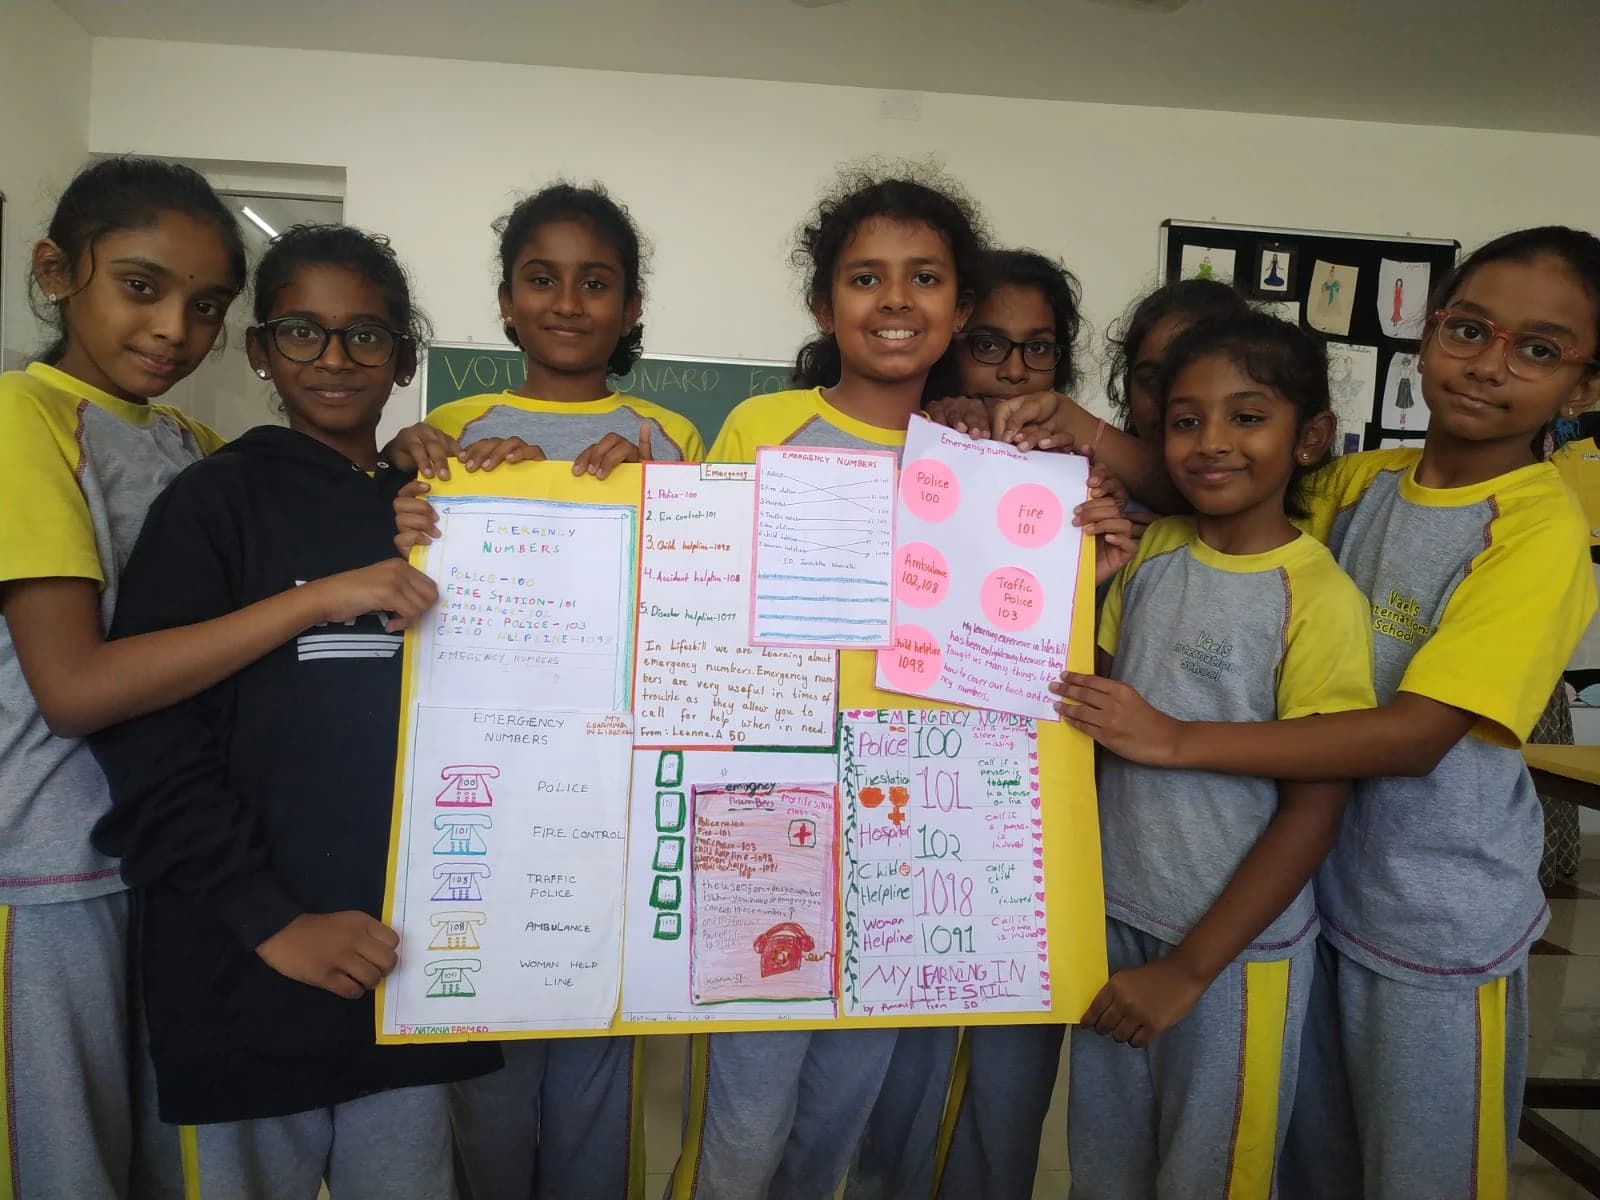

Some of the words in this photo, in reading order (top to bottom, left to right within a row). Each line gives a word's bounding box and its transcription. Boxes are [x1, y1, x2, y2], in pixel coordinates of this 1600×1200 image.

[612, 367, 720, 393] ONARD
[941, 432, 985, 456] Emergency
[782, 452, 830, 464] EMERGENCY
[836, 457, 877, 468] NUMBERS
[917, 471, 949, 489] Police
[921, 491, 940, 504] 100
[1018, 504, 1044, 520] Fire
[1018, 523, 1035, 535] 101
[482, 541, 560, 553] NUMBERS
[996, 576, 1033, 593] Traffic
[1003, 592, 1033, 608] Police
[998, 607, 1018, 621] 103
[1374, 619, 1414, 643] School
[645, 640, 661, 651] In
[715, 645, 728, 653] we
[736, 646, 752, 655] are
[808, 651, 831, 663] about
[643, 657, 697, 674] emergency
[898, 655, 925, 673] 1098
[672, 678, 688, 687] are
[697, 680, 720, 697] very
[728, 683, 765, 700] useful
[772, 688, 784, 699] in
[792, 689, 818, 701] times
[821, 692, 832, 706] of
[642, 689, 680, 702] trouble
[686, 696, 698, 704] as
[712, 693, 735, 715] they
[742, 700, 769, 712] allow
[775, 706, 794, 722] you
[802, 705, 814, 717] to
[474, 713, 565, 728] EMERGENCY
[641, 706, 665, 719] call
[680, 708, 697, 724] for
[710, 711, 730, 728] help
[741, 719, 771, 731] when
[779, 718, 793, 732] in
[877, 709, 970, 727] EMERGENCY
[485, 733, 548, 745] NUMBERS
[859, 731, 908, 758] Police
[913, 726, 962, 759] 100
[537, 781, 589, 793] POLICE
[455, 827, 469, 835] 101
[533, 826, 567, 838] FIRE
[572, 829, 626, 840] CONTROL
[915, 824, 962, 862] 102
[858, 859, 898, 880] Child
[527, 873, 577, 884] TRAFFIC
[530, 888, 574, 899] POLICE
[860, 883, 910, 907] Helpline
[914, 867, 973, 917] 1098
[450, 923, 465, 932] 108
[525, 922, 592, 933] AMBULANCE
[863, 929, 913, 952] Helpline
[921, 923, 976, 954] 1091
[519, 959, 560, 969] WOMAN
[570, 960, 598, 969] HELP
[544, 976, 575, 987] LINE
[861, 964, 912, 997] MY
[917, 960, 988, 989] LEARNING
[990, 959, 1026, 984] IN
